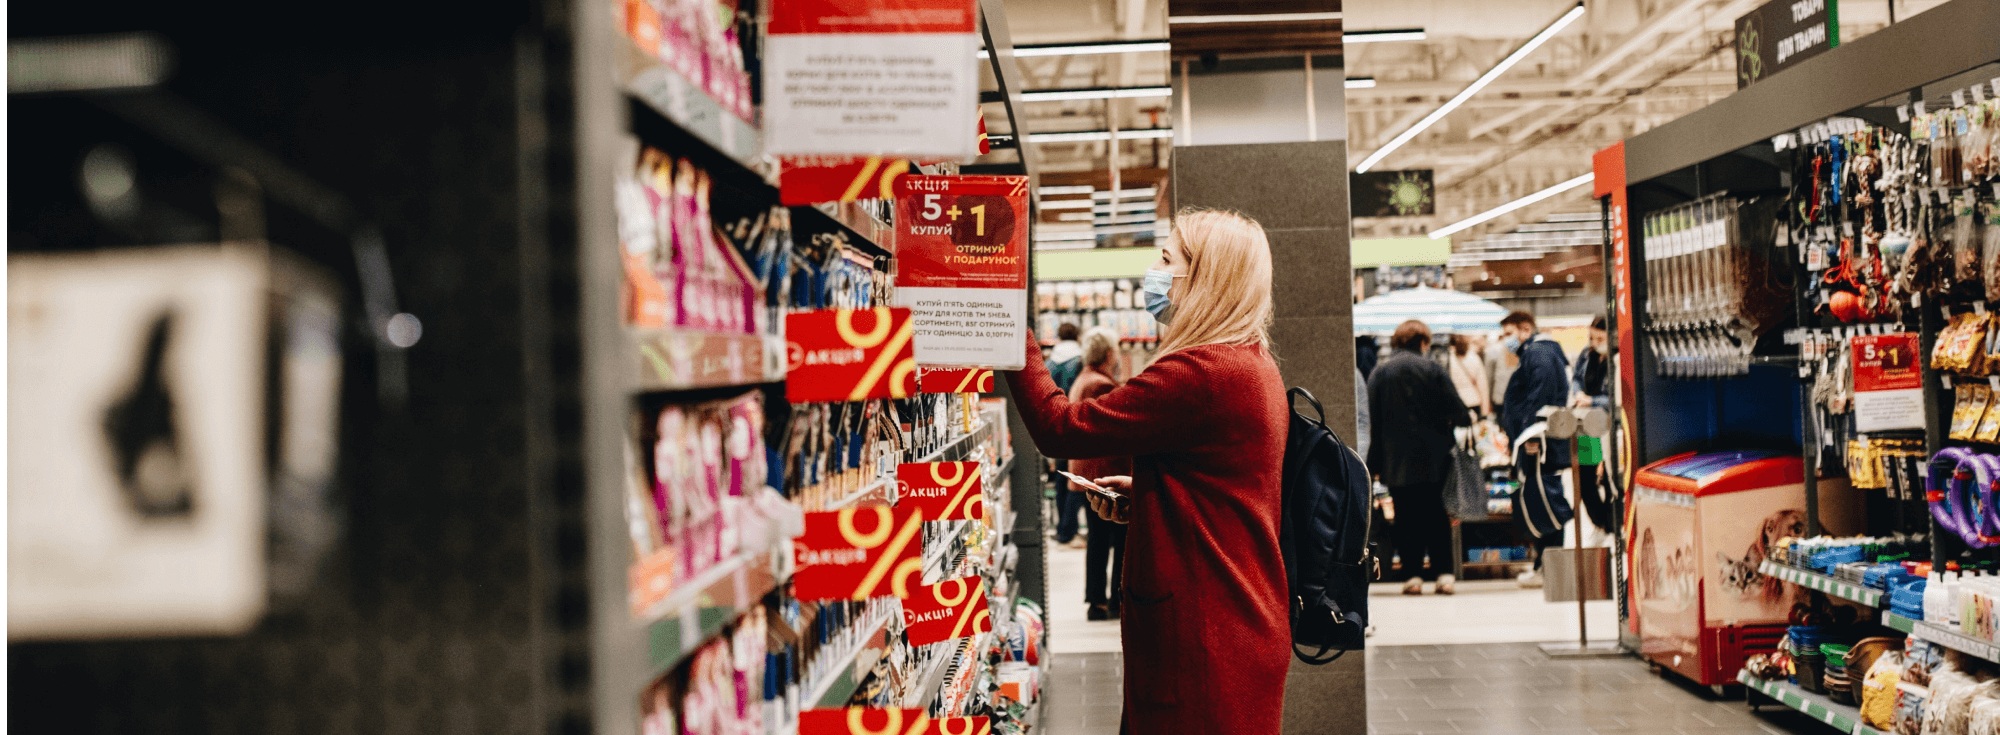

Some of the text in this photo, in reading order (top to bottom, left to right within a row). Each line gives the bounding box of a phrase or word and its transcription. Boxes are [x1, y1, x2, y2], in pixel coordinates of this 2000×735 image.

[1791, 0, 1824, 23] ТОВАРИ
[1777, 22, 1826, 64] ДЛЯ ТВАРИН
[906, 180, 949, 192] АКЦІЯ
[911, 224, 952, 235] КУПУЙ
[956, 244, 1005, 254] ОТРИМУЙ
[916, 299, 941, 307] КУПУЙ
[966, 301, 1003, 309] ОДИНИЦЬ
[911, 319, 964, 328] СОРТИМЕНТІ,
[979, 320, 1015, 328] ОТРИМУЙ
[933, 330, 973, 338] ОДИНИЦЮ
[910, 487, 947, 498] АКЦІЯ
[917, 607, 954, 623] АКЦІЯ
